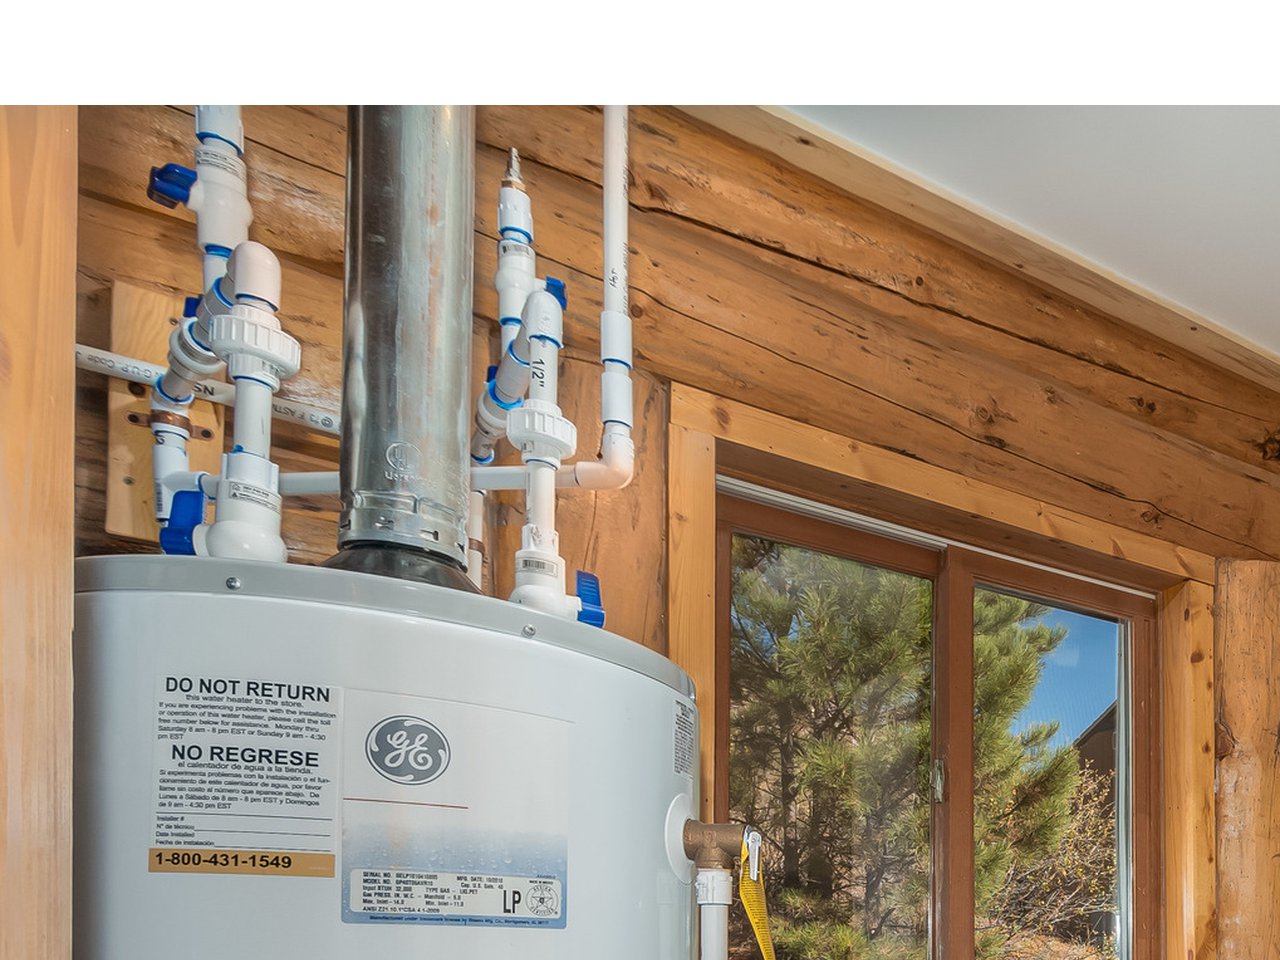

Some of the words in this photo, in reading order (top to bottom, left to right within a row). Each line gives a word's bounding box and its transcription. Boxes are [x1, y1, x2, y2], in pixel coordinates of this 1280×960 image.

[166, 677, 193, 692] DO
[199, 678, 240, 695] NOT
[247, 681, 330, 703] RETURN
[202, 694, 225, 702] water
[281, 700, 304, 708] store.
[191, 704, 233, 712] experiencing
[235, 705, 268, 713] problems
[299, 709, 336, 719] installation
[172, 744, 202, 760] NO
[210, 746, 319, 767] REGRESE
[385, 729, 433, 771] GE
[187, 762, 229, 770] calentador
[243, 765, 265, 774] agua
[275, 765, 283, 773] la
[285, 766, 313, 775] tienda.
[155, 852, 292, 869] 1-800-431-1549
[503, 890, 521, 913] LP
